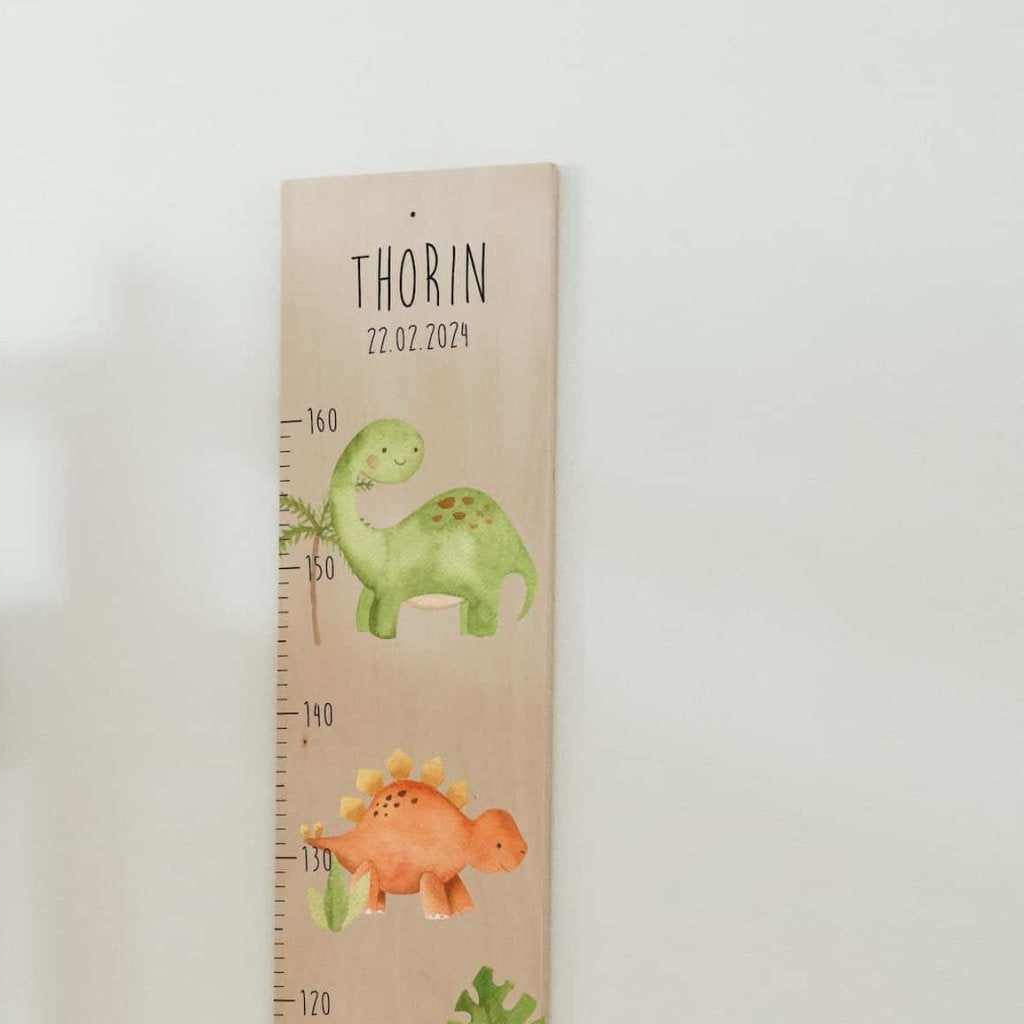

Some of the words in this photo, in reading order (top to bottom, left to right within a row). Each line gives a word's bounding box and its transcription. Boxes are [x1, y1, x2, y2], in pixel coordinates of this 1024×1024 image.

[351, 242, 486, 311] THORIN
[367, 321, 469, 355] 22.02.2024
[307, 407, 337, 434] 160
[305, 554, 334, 582] 150
[304, 700, 333, 728] 140
[302, 846, 332, 872] 130
[300, 989, 331, 1016] 120
